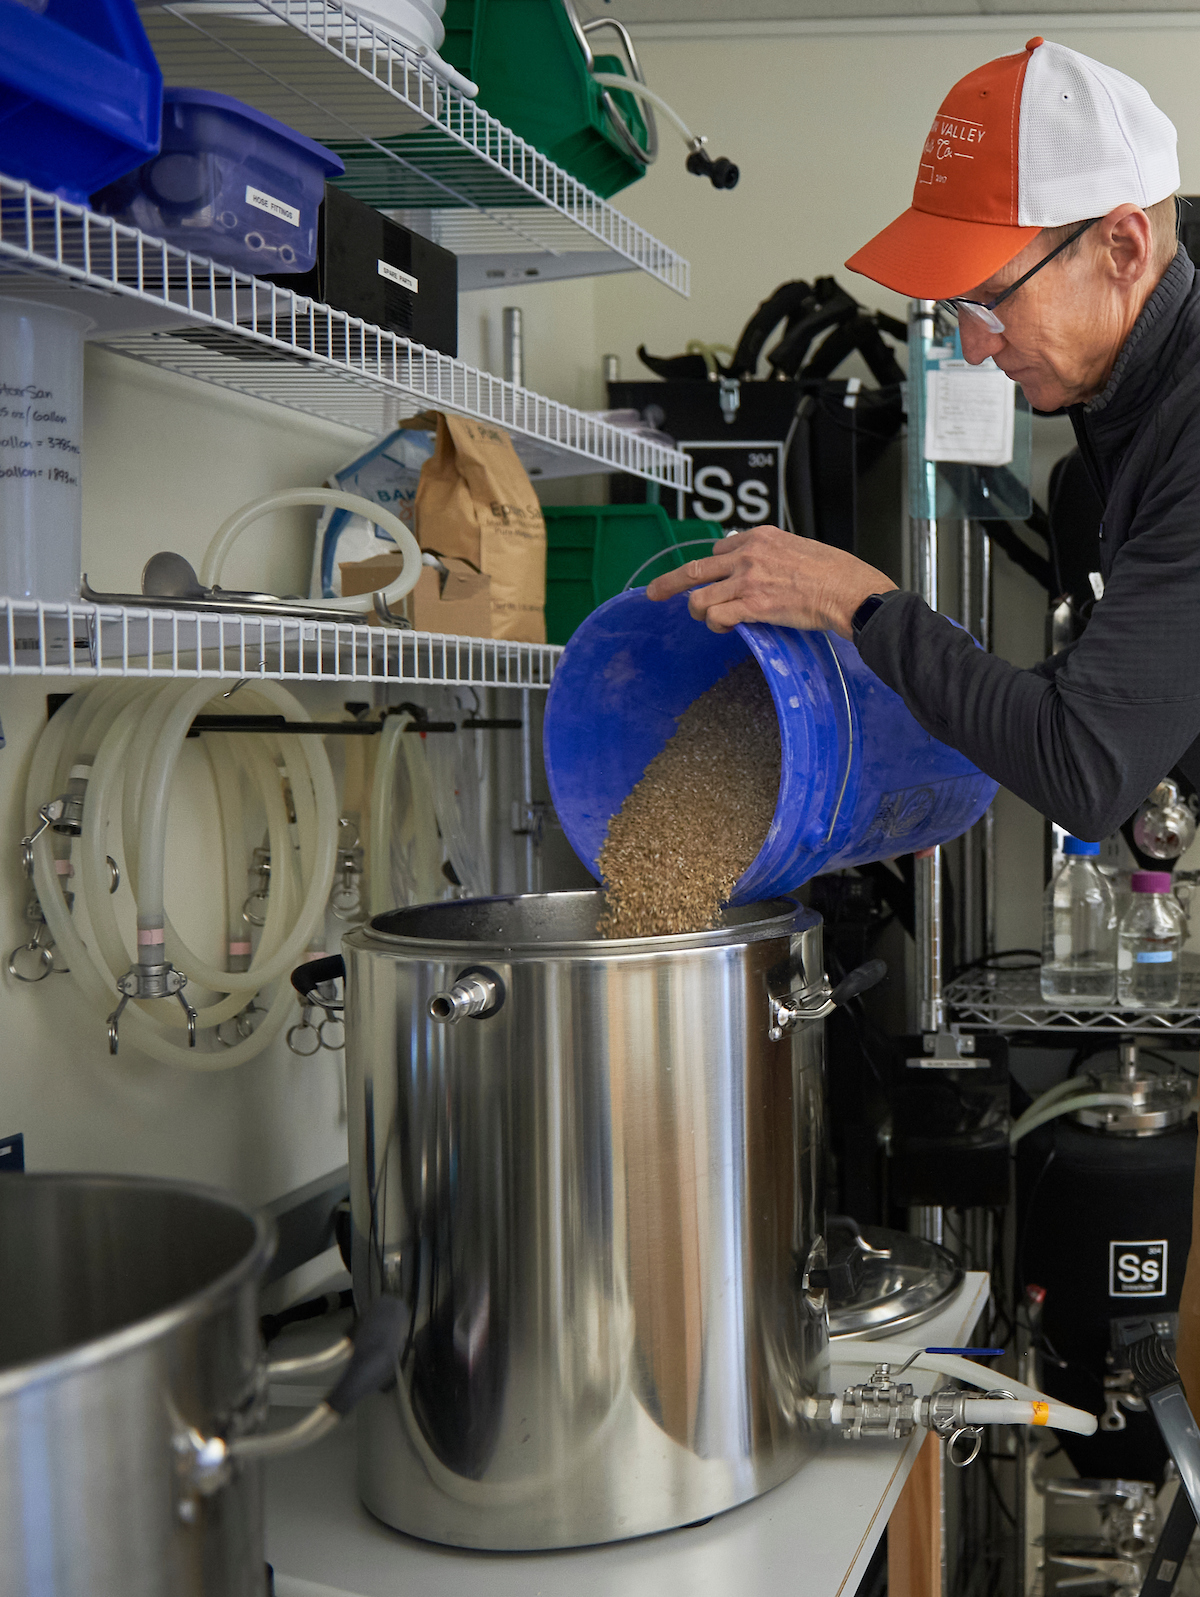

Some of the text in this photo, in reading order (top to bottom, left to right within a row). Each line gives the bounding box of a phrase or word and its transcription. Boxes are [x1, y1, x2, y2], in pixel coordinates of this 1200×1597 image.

[940, 121, 986, 143] VALLEY
[252, 194, 293, 220] HOSE FITTINGS
[399, 275, 413, 287] PARTS
[0, 436, 33, 449] allon
[748, 453, 774, 468] 304
[692, 465, 771, 524] Ss
[1117, 1253, 1160, 1283] Ss
